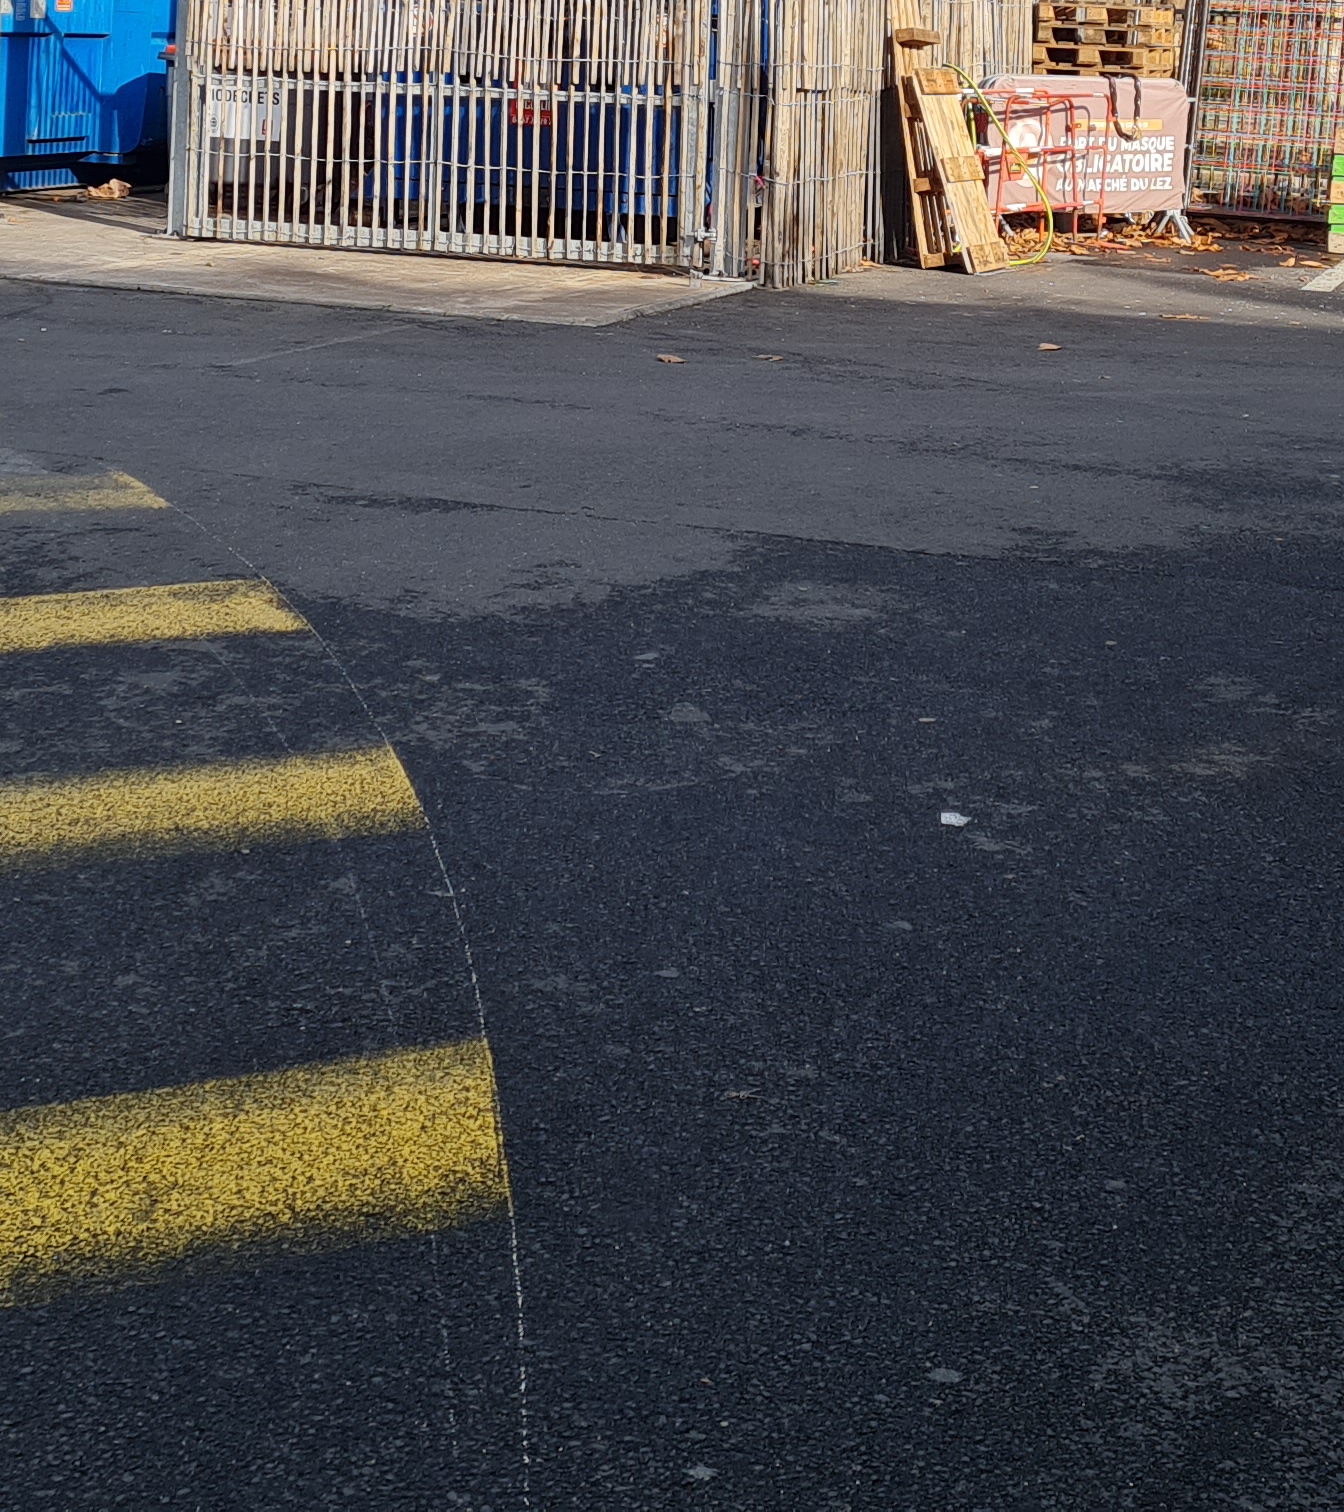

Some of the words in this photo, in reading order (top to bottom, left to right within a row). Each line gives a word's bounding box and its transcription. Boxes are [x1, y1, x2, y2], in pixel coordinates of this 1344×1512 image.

[1120, 135, 1175, 152] MASQUE
[1131, 178, 1148, 191] DU
[1150, 177, 1173, 190] LEZ
